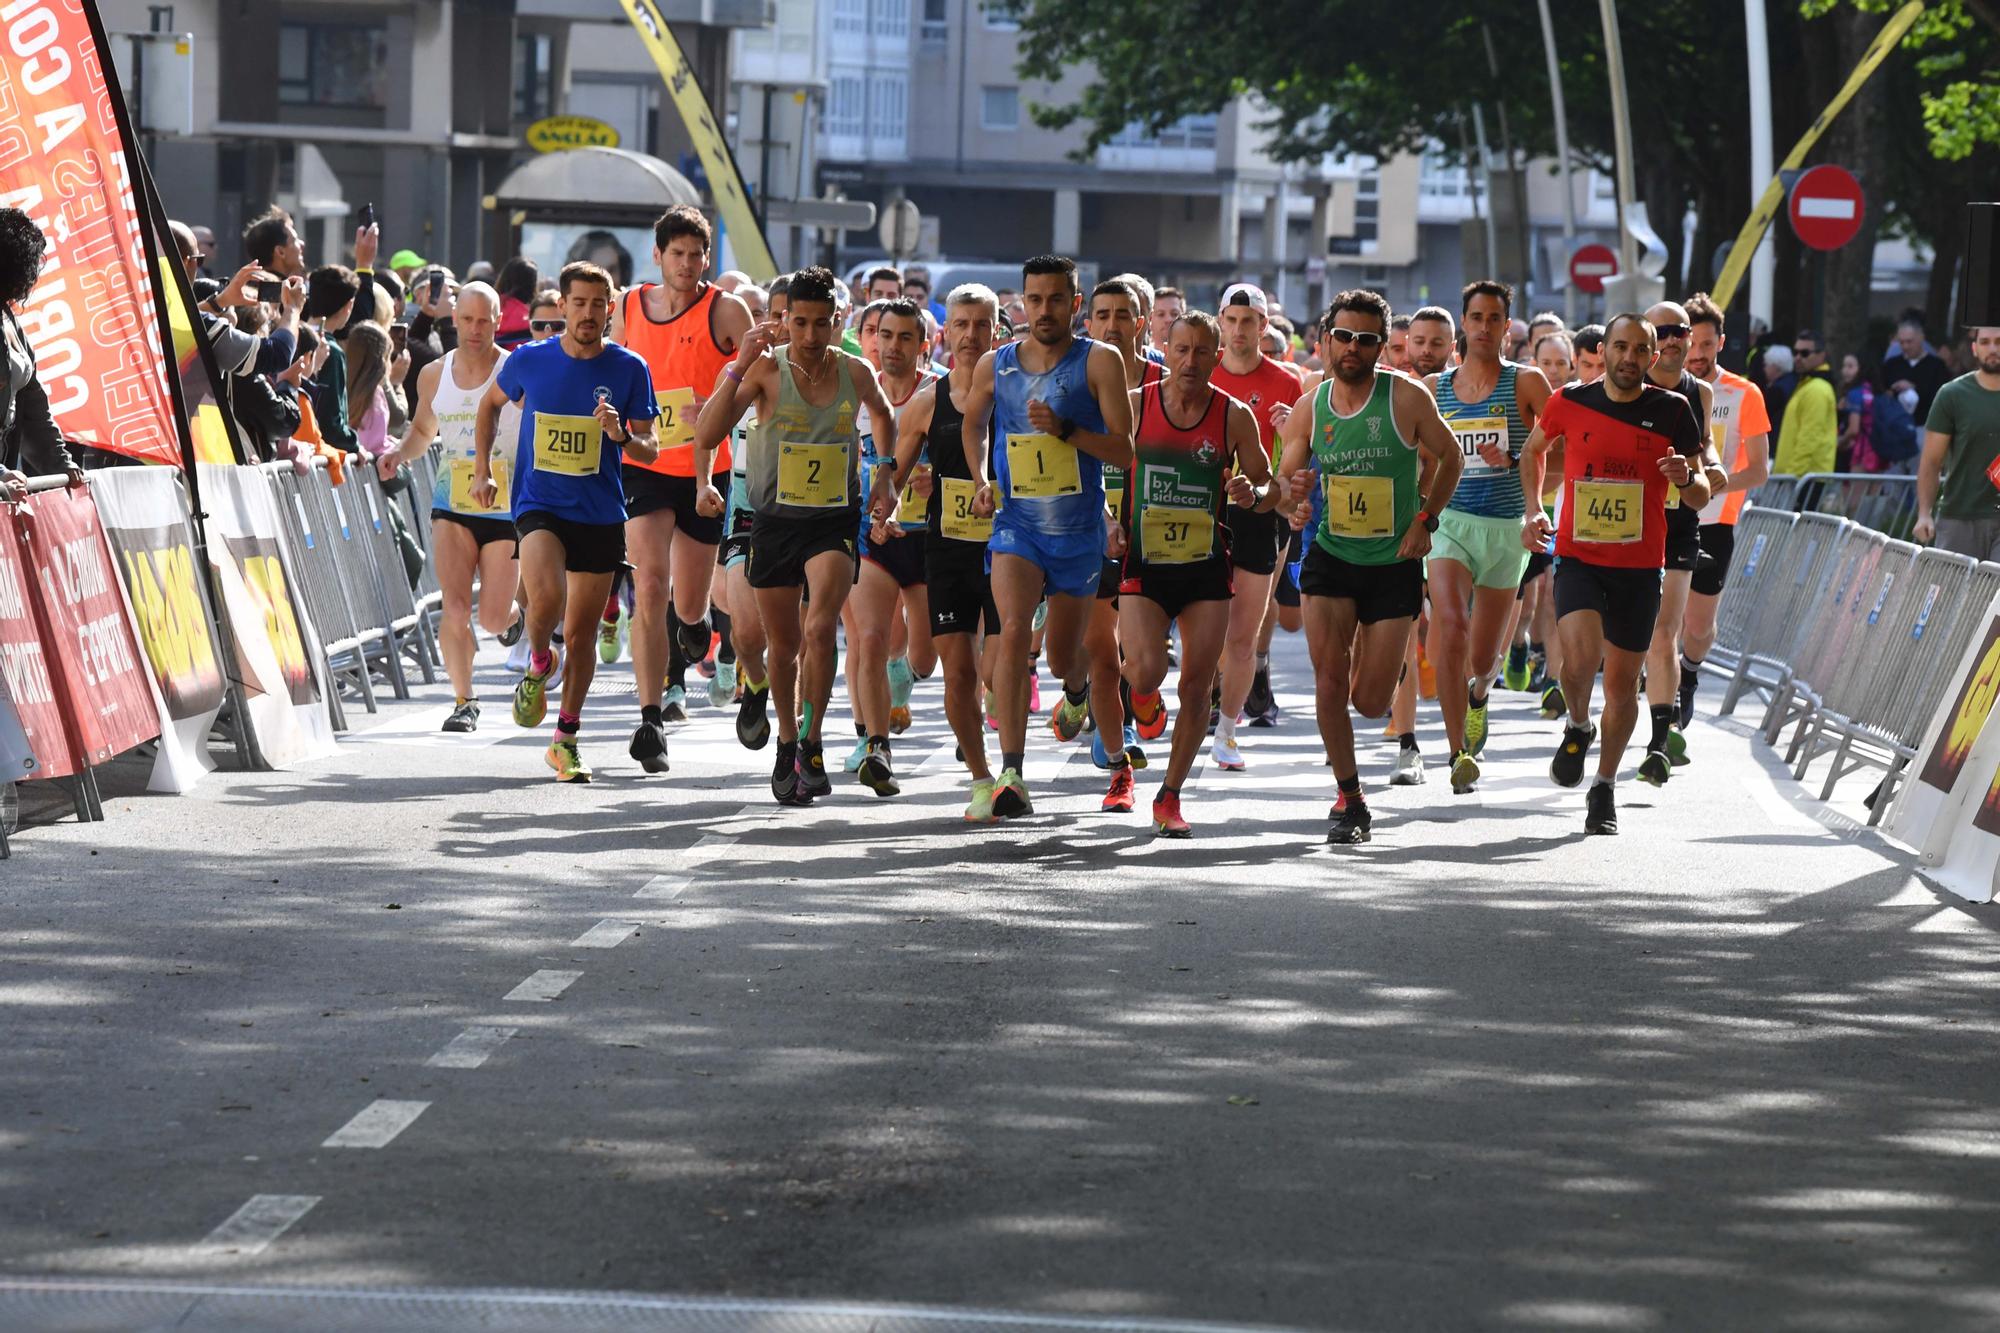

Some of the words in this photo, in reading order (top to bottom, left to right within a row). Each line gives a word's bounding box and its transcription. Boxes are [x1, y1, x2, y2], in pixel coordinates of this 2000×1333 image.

[438, 411, 477, 422] Runnin
[547, 429, 586, 459] 290
[1317, 453, 1338, 464] SAN
[1341, 447, 1392, 462] MIGUEL
[1456, 432, 1499, 456] 022
[807, 460, 821, 484] 2
[1037, 450, 1044, 474] 1
[1152, 475, 1172, 493] by
[1348, 492, 1367, 515] 14
[1588, 498, 1627, 522] 445
[1164, 522, 1190, 542] 37
